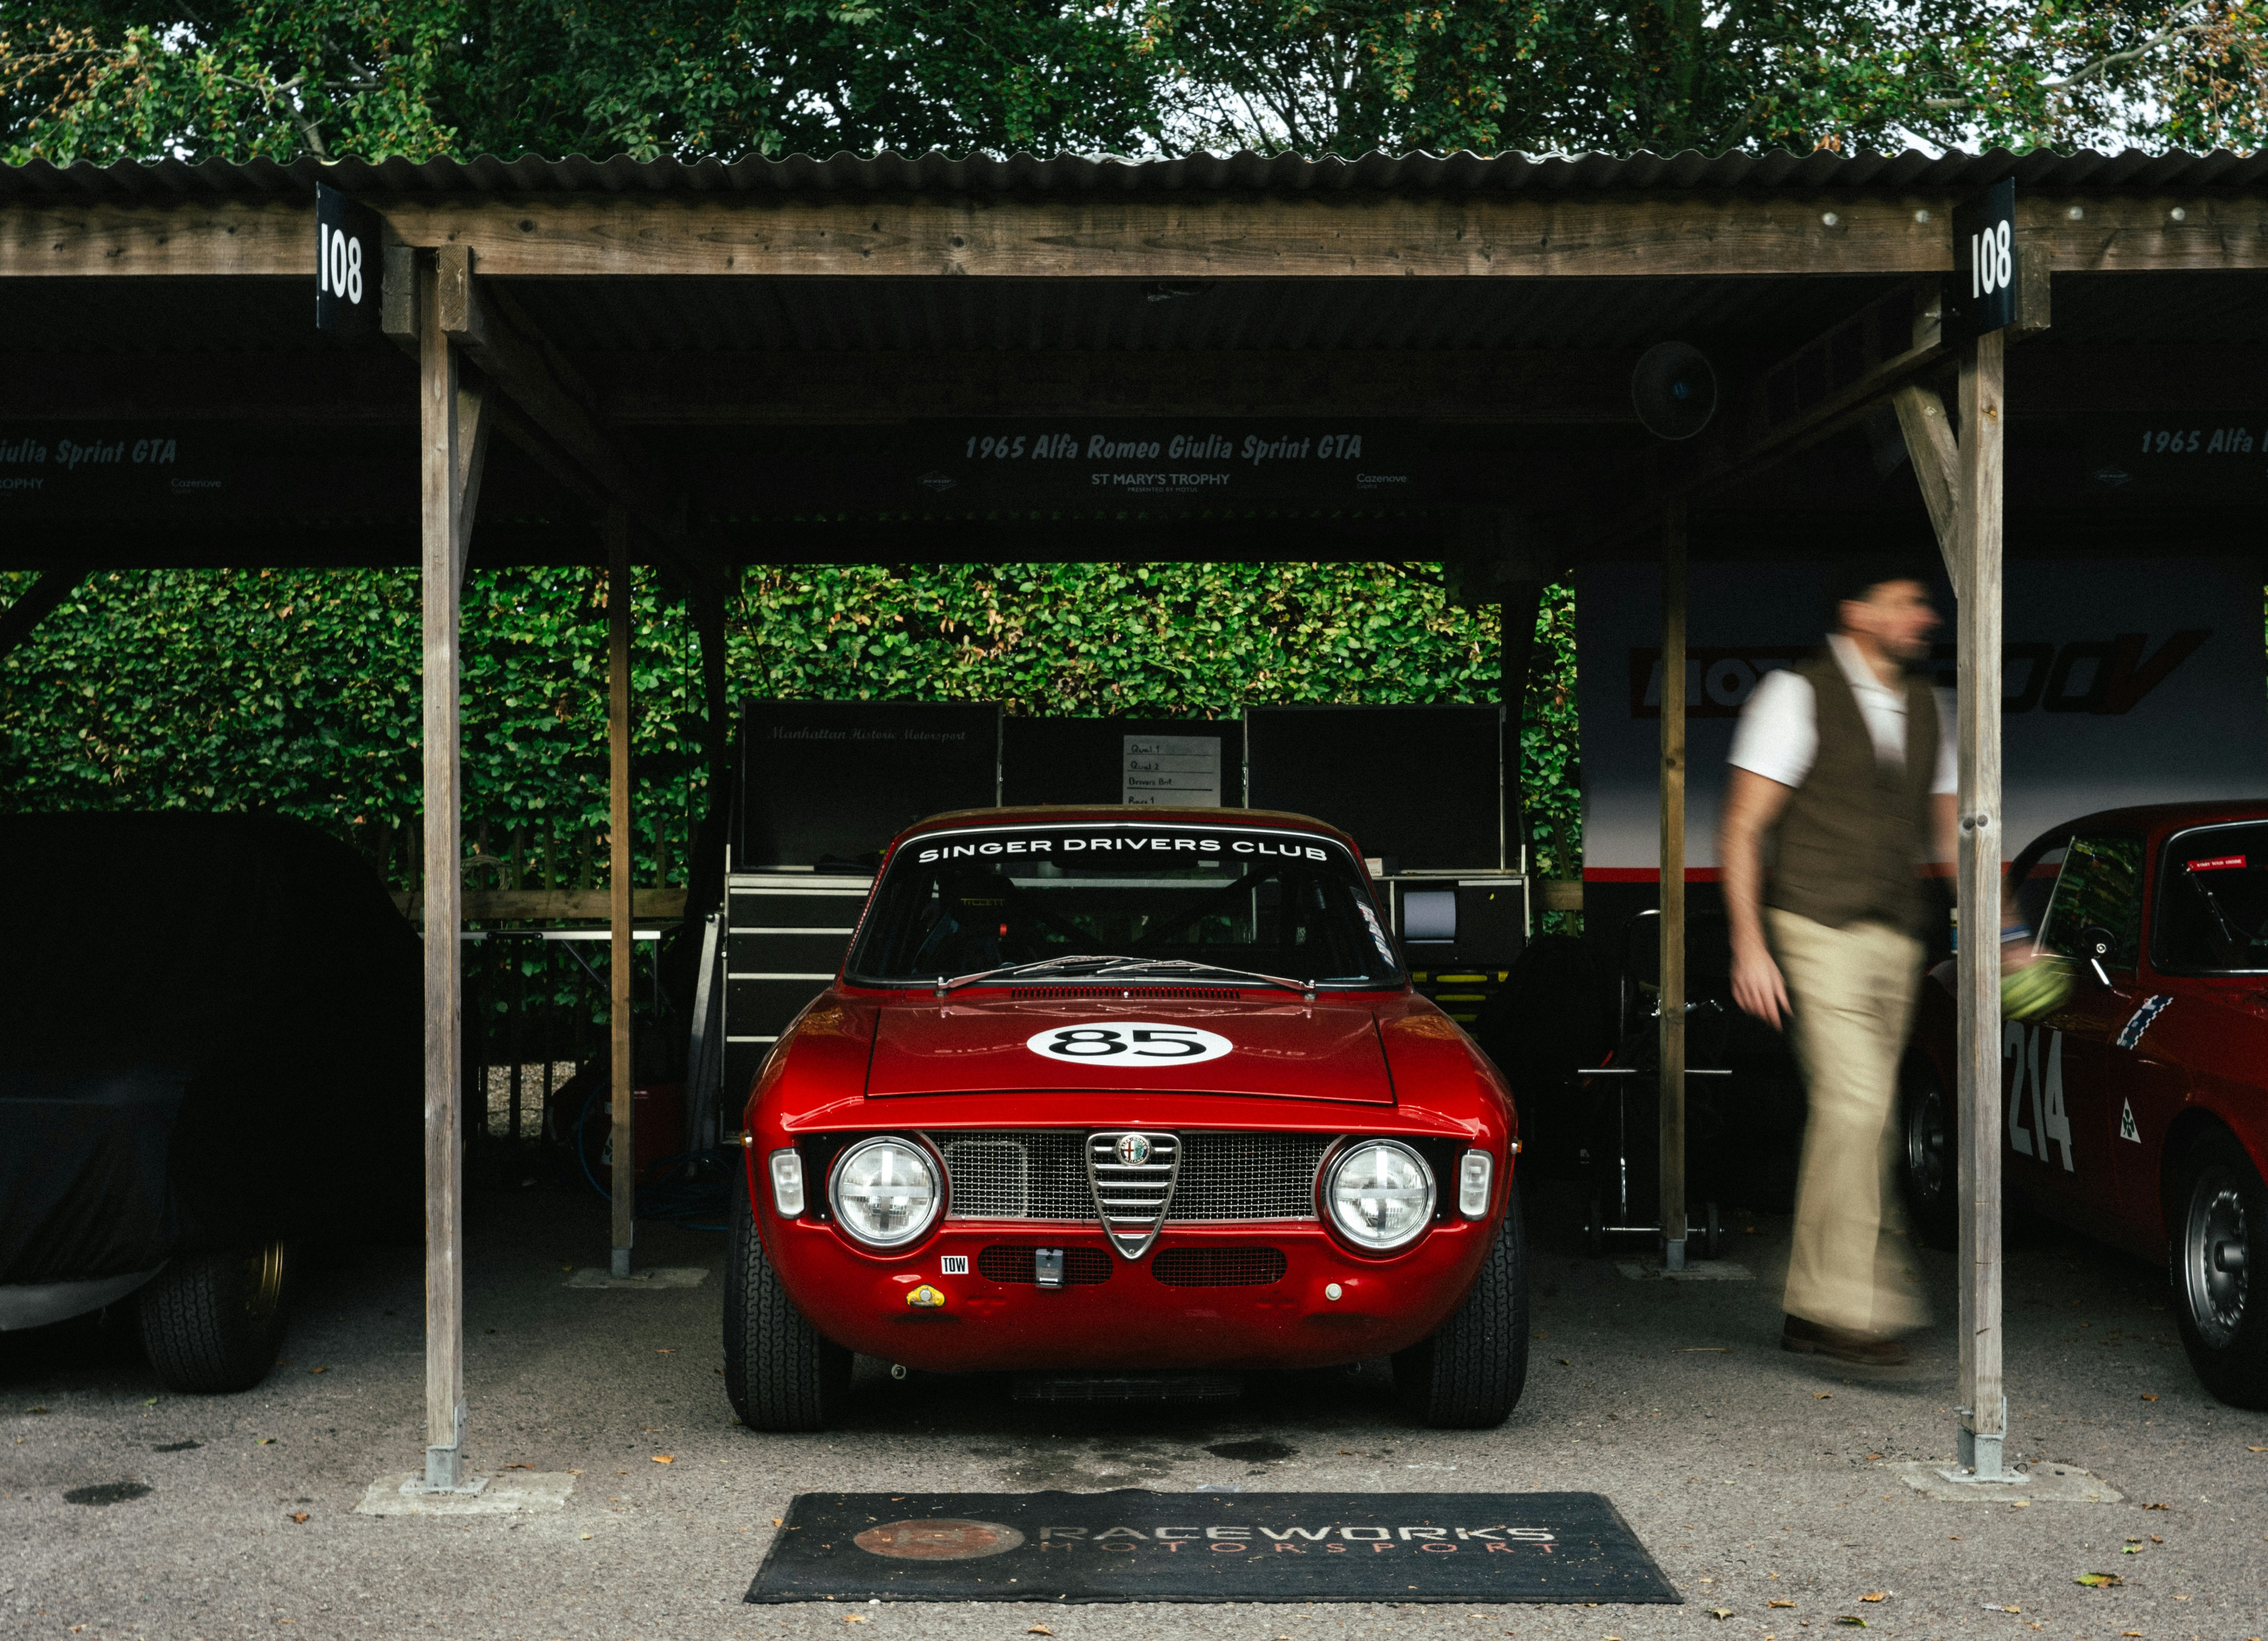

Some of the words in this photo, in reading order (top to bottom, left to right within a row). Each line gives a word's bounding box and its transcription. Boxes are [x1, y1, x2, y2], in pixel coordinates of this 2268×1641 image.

[321, 222, 362, 304] 108
[1972, 219, 2011, 299] 108
[967, 436, 1026, 459] 1965
[1032, 433, 1079, 459] Alfa
[1087, 434, 1161, 459] Romeo
[1168, 434, 1233, 459] Giulia
[1241, 434, 1311, 466] Sprint
[1317, 434, 1362, 459] GTA
[2141, 429, 2202, 453] 1965
[2206, 426, 2254, 454] Alfa
[55, 439, 125, 471] Sprint
[131, 439, 177, 464] GTA
[0, 478, 44, 490] OPHY
[171, 478, 222, 487] Cazenove
[1091, 474, 1110, 484] ST
[1113, 474, 1166, 484] MARY'S
[1169, 474, 1230, 484] TROPHY
[1356, 473, 1407, 483] Cazenove
[767, 726, 846, 740] Manhattan
[849, 727, 897, 740] Historic
[918, 840, 1052, 863] SINGER
[1064, 838, 1221, 851] DRIVERS
[1232, 841, 1328, 861] CLUB
[1048, 1029, 1206, 1057] 85
[2003, 1020, 2074, 1173] 214
[943, 1257, 965, 1272] TOW
[1039, 1526, 1556, 1541] RACEWORKS
[1040, 1542, 1560, 1554] MOTORSPORT
